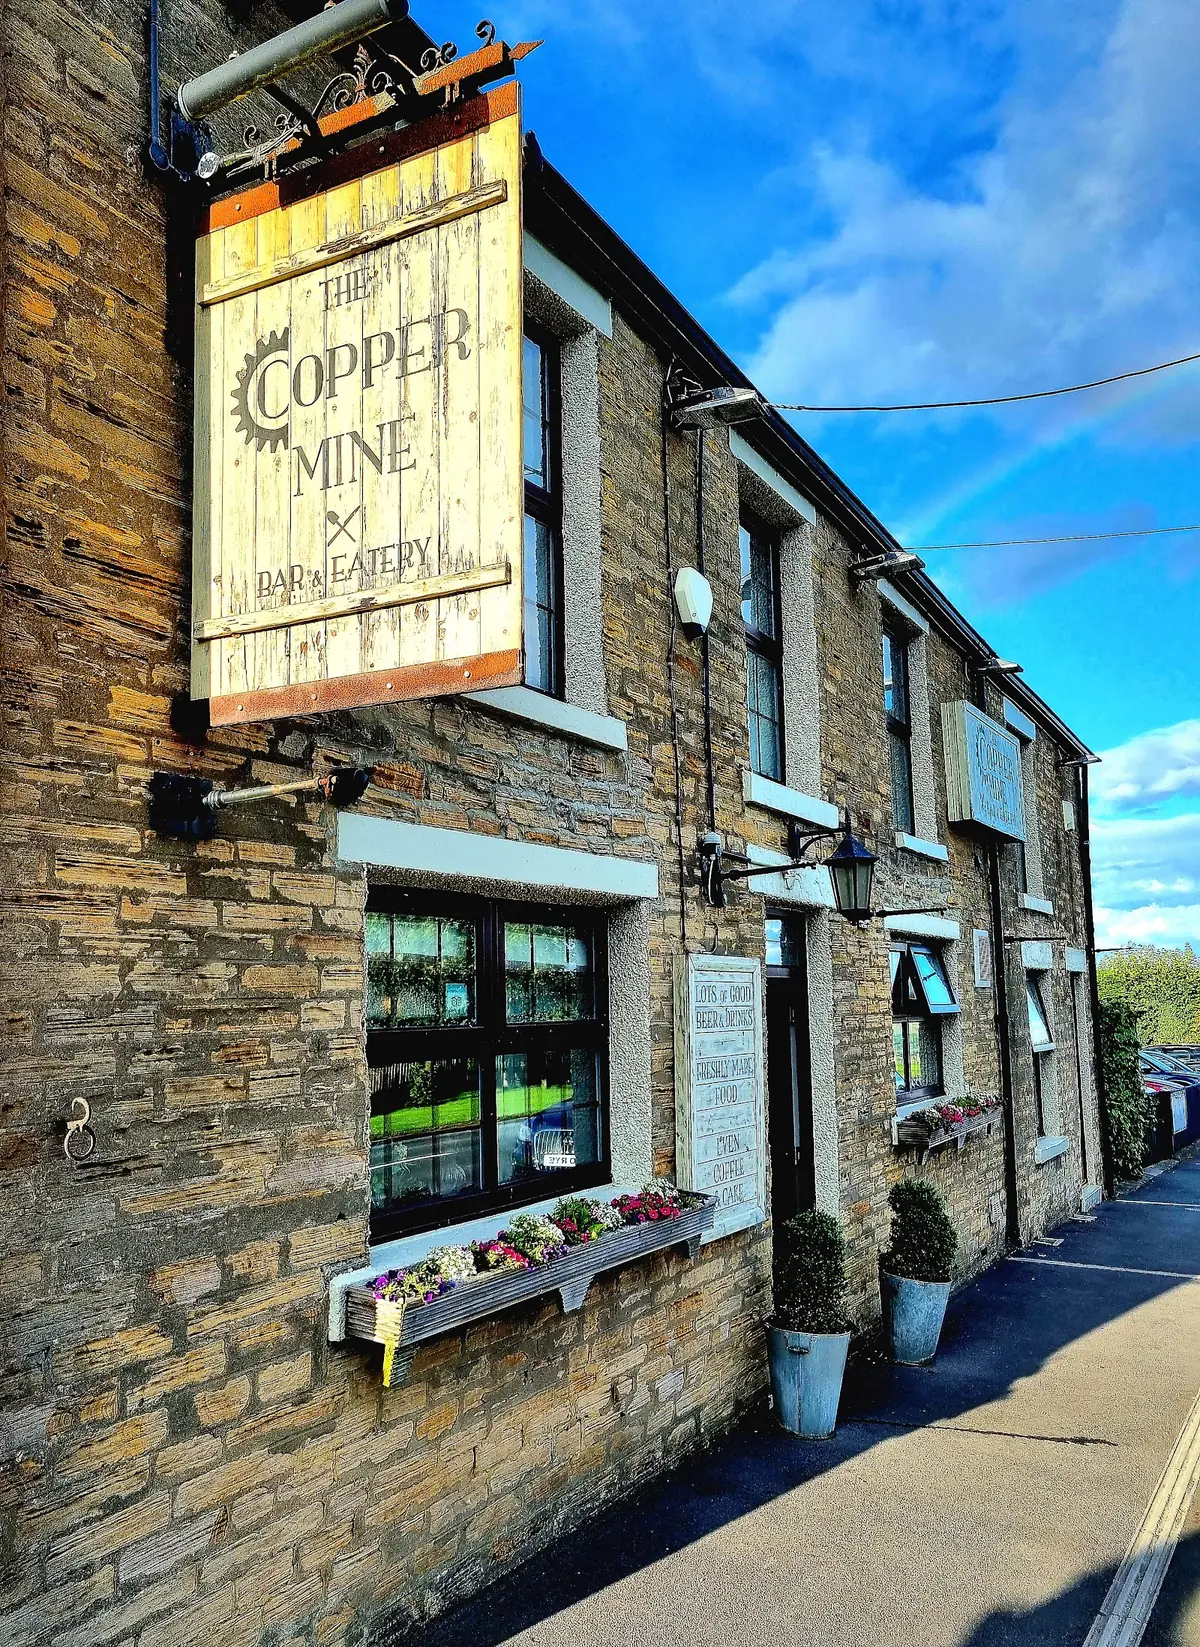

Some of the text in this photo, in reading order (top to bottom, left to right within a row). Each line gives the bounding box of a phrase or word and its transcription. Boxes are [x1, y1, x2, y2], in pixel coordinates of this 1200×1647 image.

[318, 266, 371, 312] THE
[257, 308, 472, 419] COPPER
[292, 411, 418, 498] MINE
[257, 536, 432, 599] BAR & EATERY
[979, 737, 1014, 783] COPPER
[695, 984, 717, 1003] LOTS
[729, 985, 751, 1003] GOOD
[696, 1010, 718, 1029] BEER
[725, 1008, 753, 1028] DRINKS
[696, 1057, 754, 1081] FRESHLY MADE
[715, 1084, 738, 1106] FOOD
[716, 1133, 741, 1156] EVEN
[713, 1158, 744, 1183] COFFEE
[722, 1183, 744, 1206] CAKE
